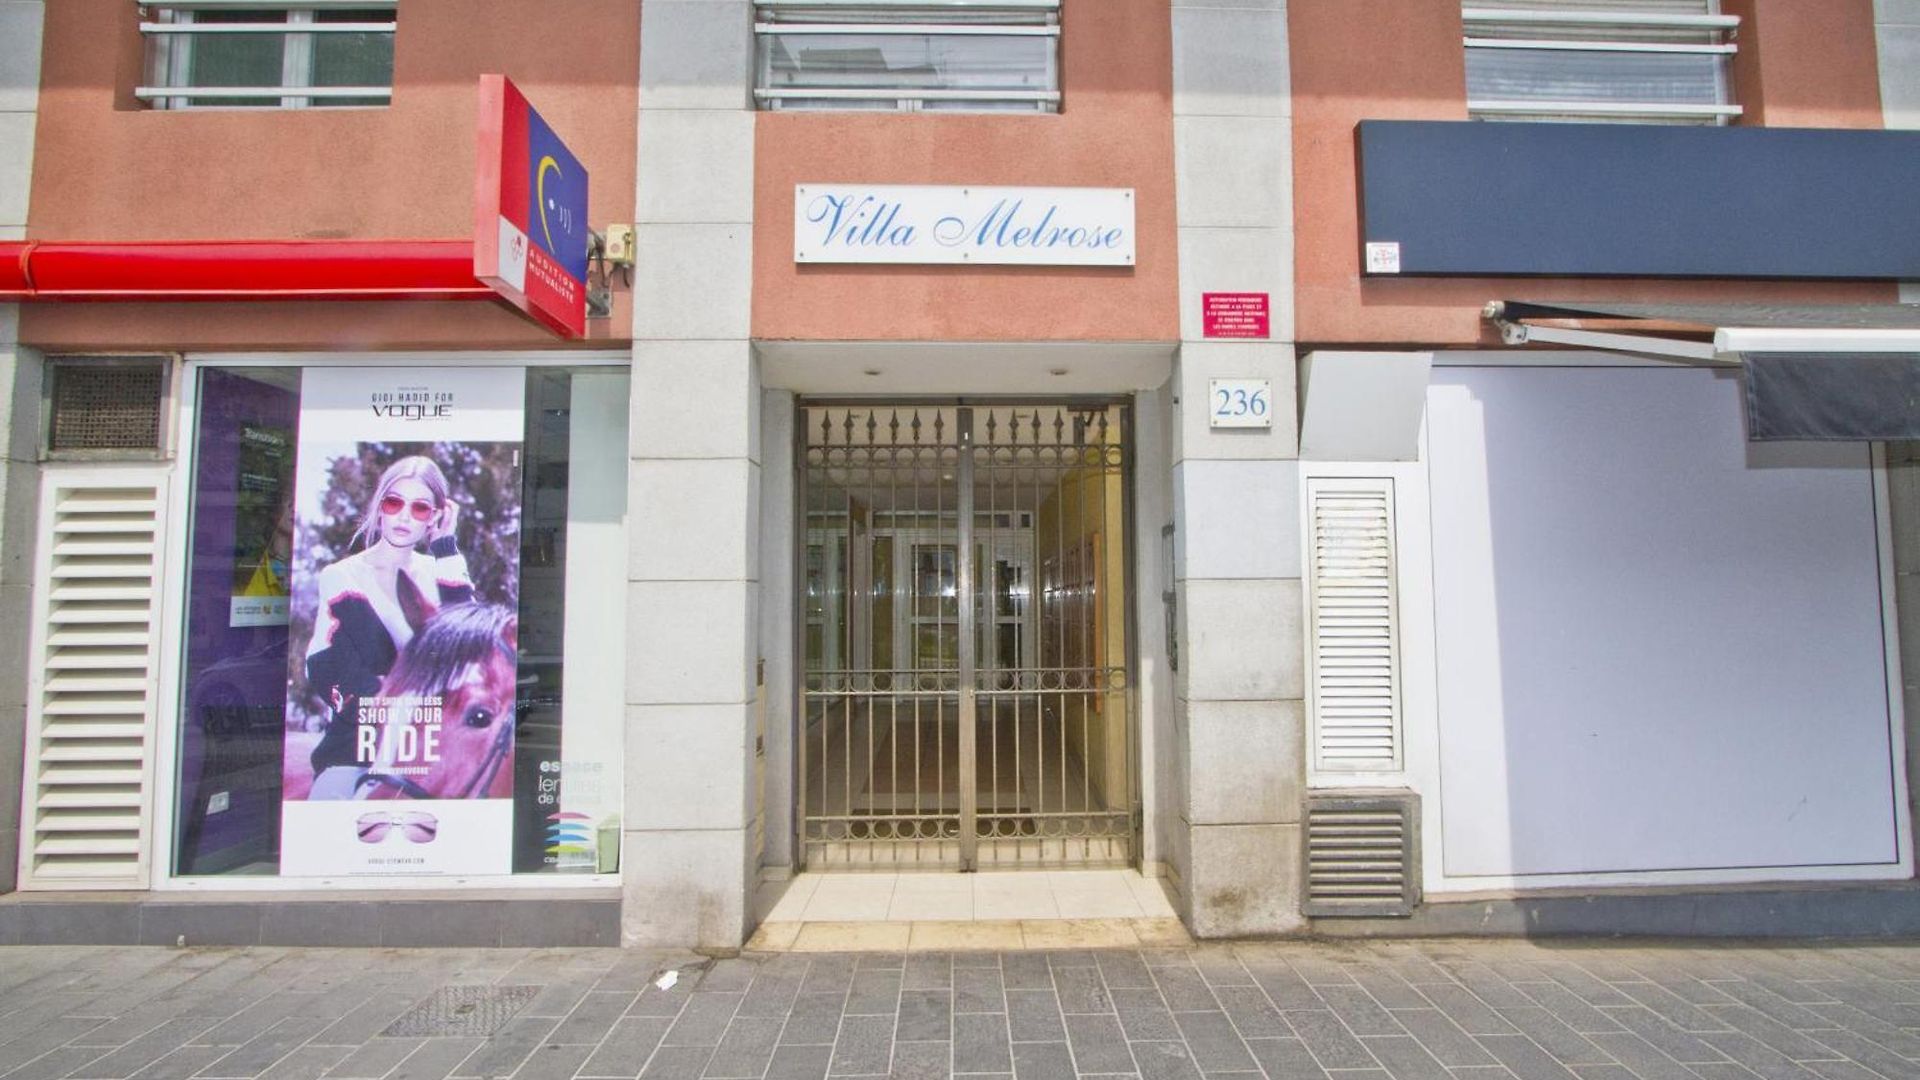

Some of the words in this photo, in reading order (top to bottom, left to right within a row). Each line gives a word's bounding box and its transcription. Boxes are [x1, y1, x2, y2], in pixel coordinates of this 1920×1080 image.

[806, 195, 918, 248] Villa
[933, 197, 1124, 250] Melrose
[398, 392, 430, 402] HADID
[434, 392, 453, 402] FOR
[1217, 389, 1265, 416] 236
[405, 707, 442, 724] YOUR
[357, 724, 442, 762] RIDE
[538, 794, 554, 805] de
